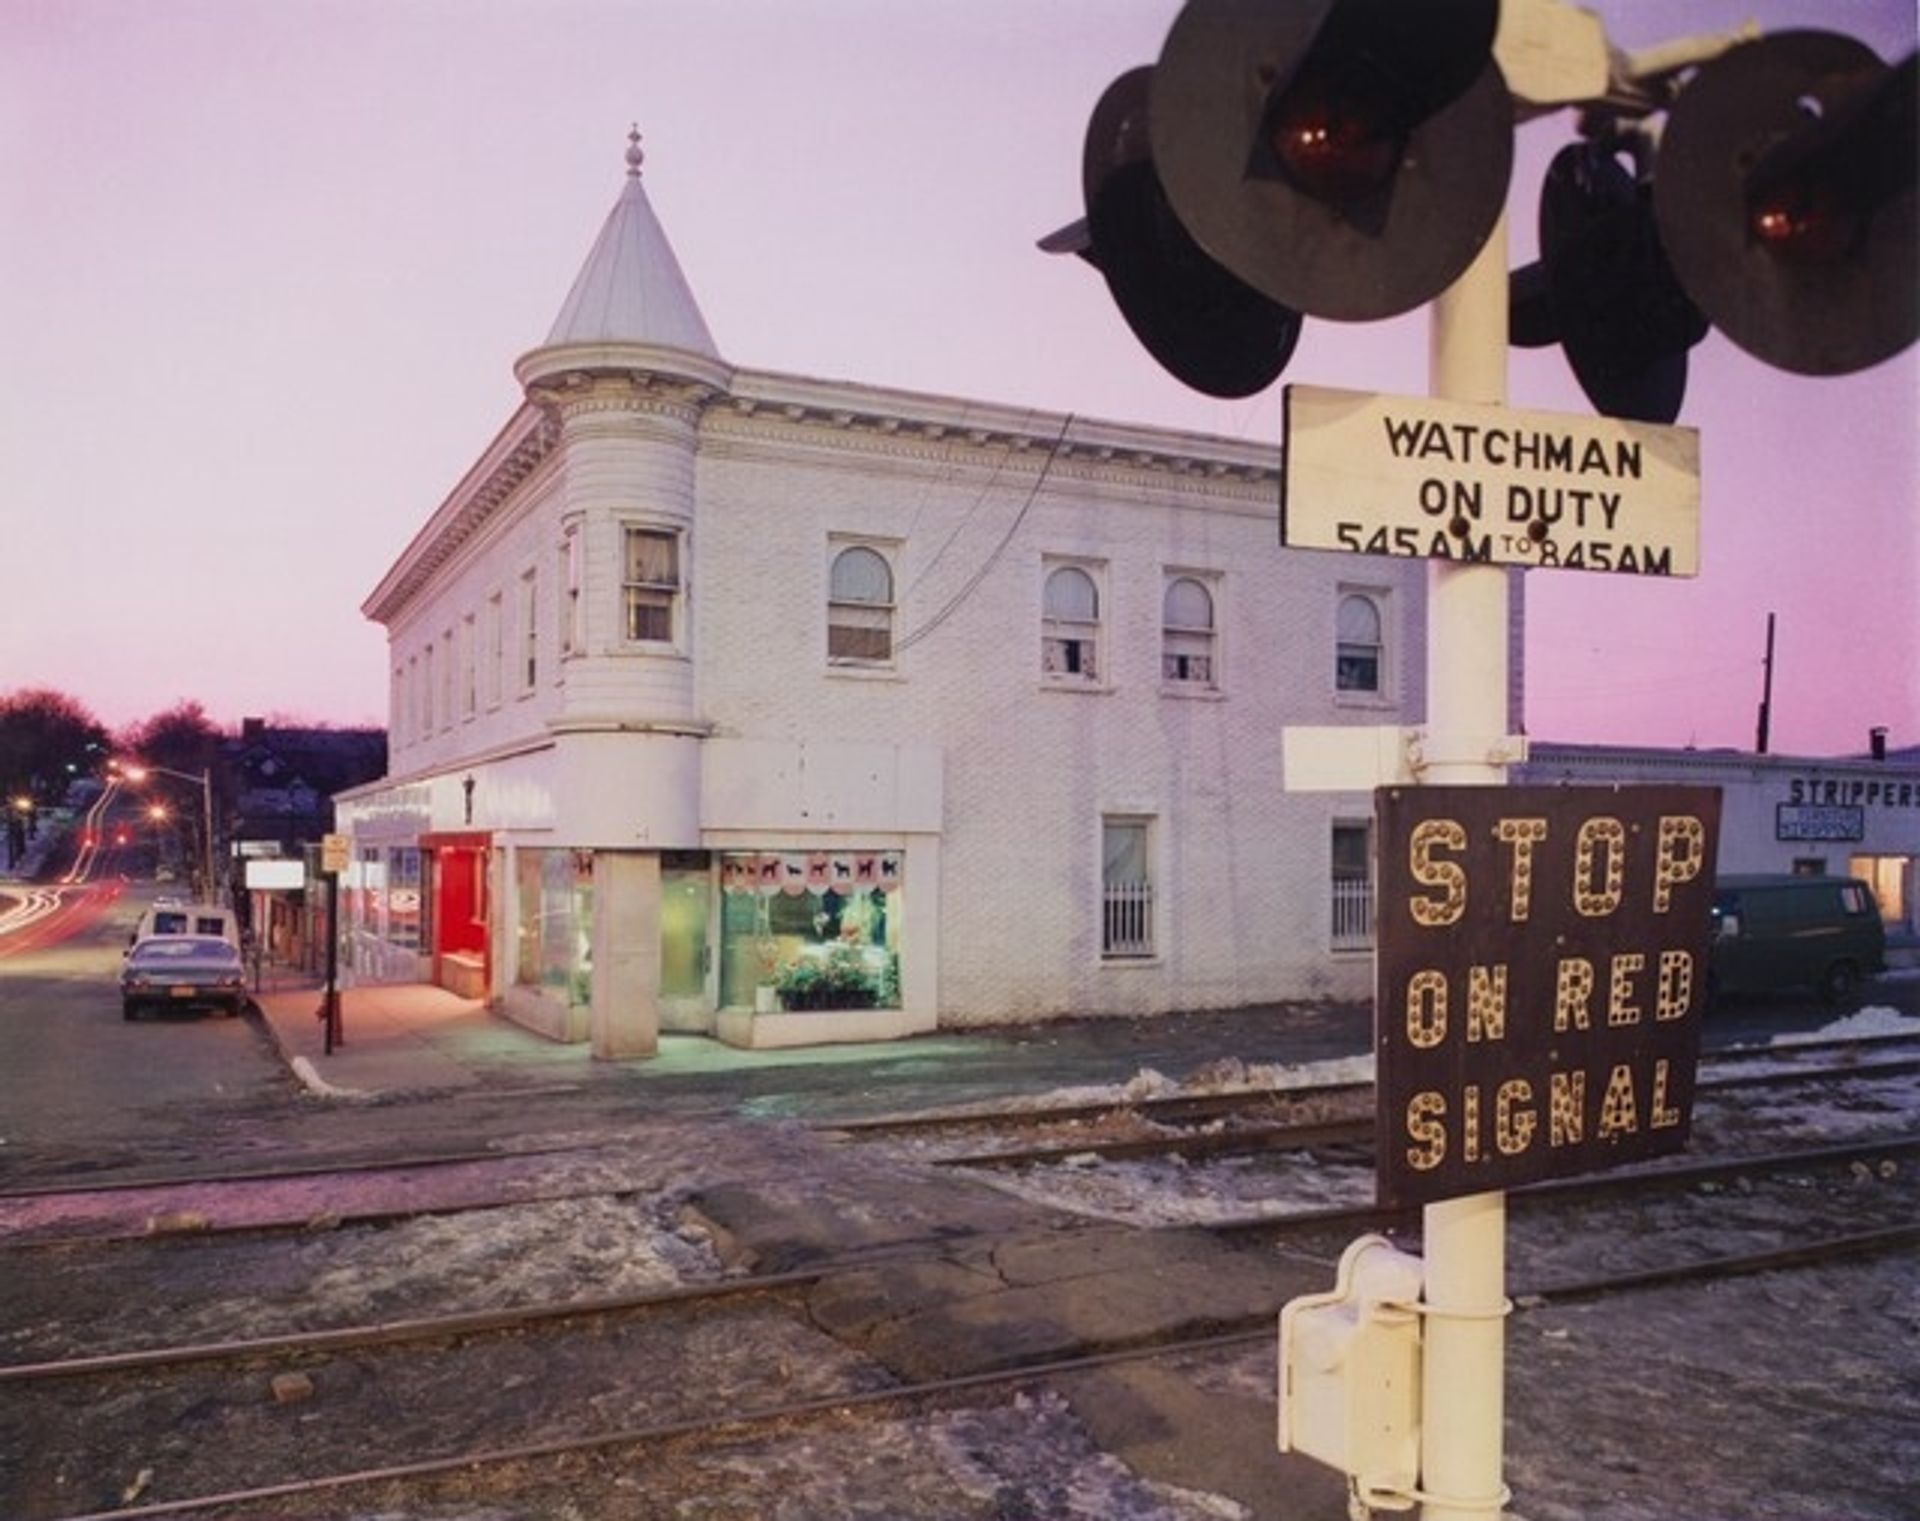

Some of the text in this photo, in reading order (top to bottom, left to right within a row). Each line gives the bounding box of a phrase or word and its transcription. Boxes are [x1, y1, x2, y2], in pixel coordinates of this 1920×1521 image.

[1384, 416, 1642, 479] WATCHMAN
[1419, 478, 1621, 530] ON DUTY
[1501, 534, 1532, 555] TO
[1409, 815, 1705, 927] STOP
[1406, 950, 1694, 1049] ON RED
[1406, 1059, 1680, 1170] SIGNAL
